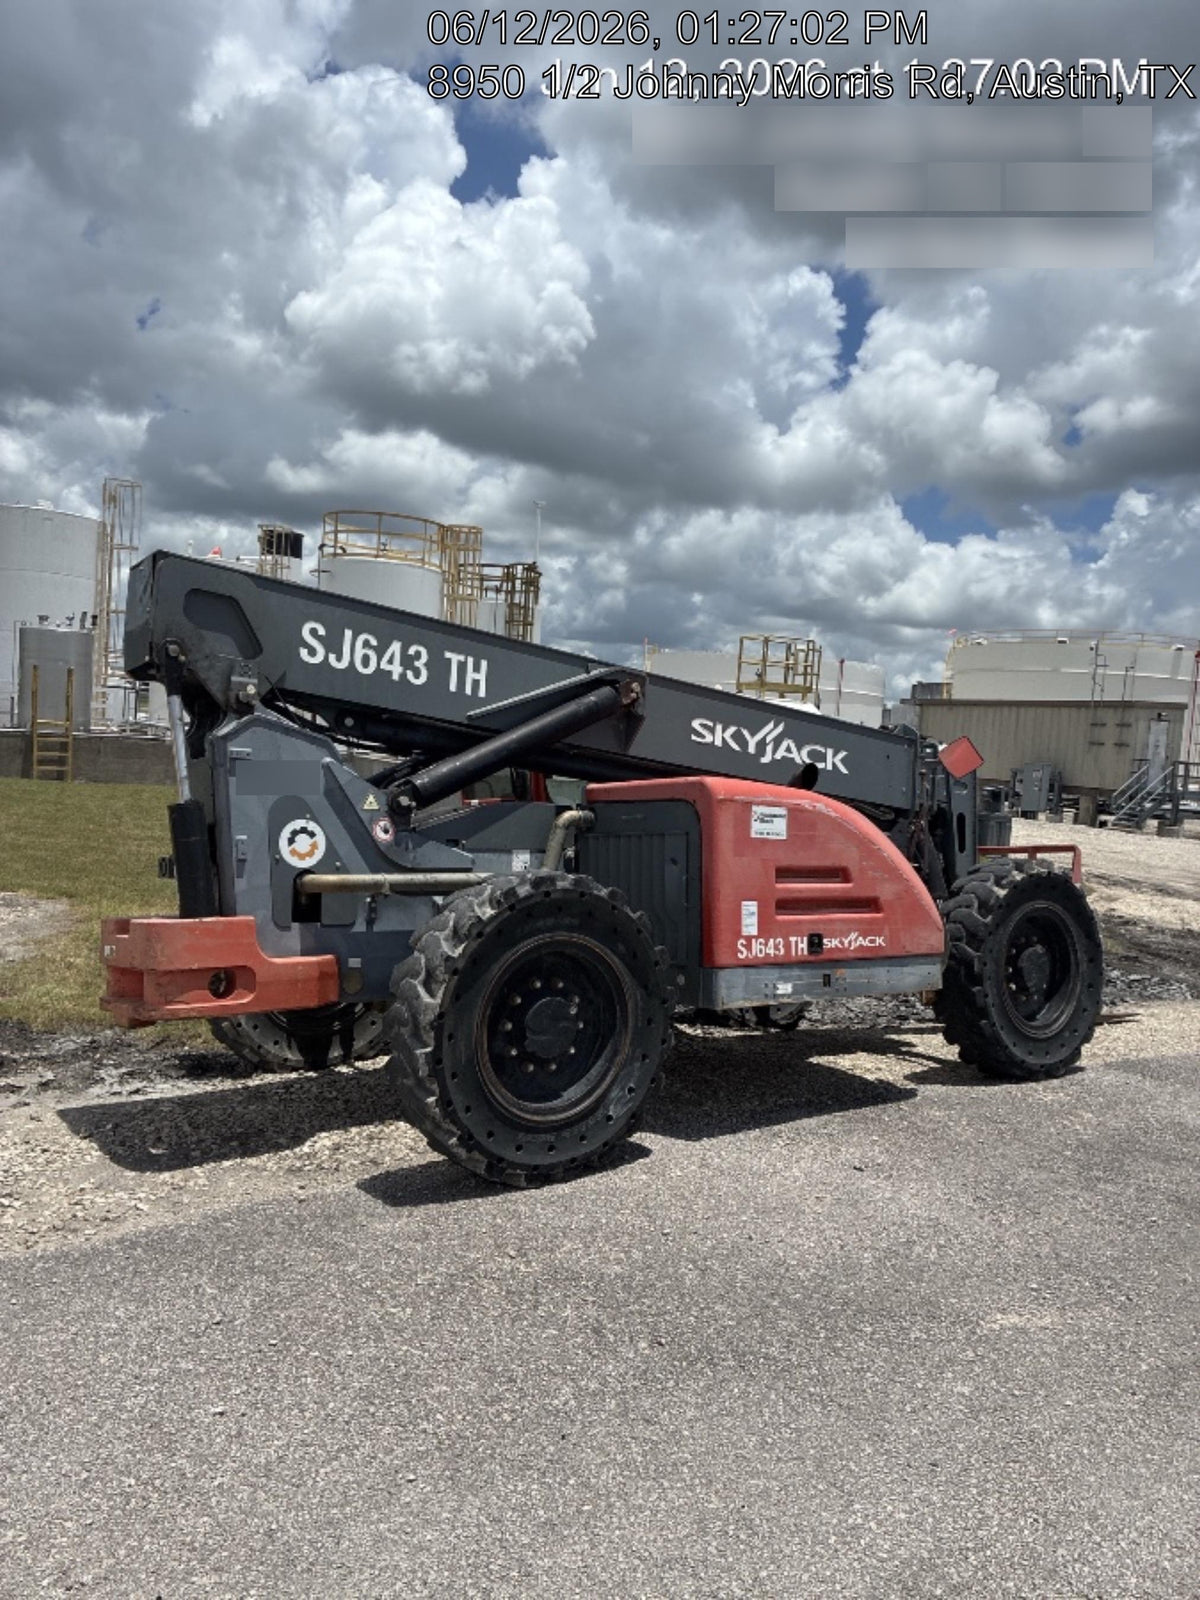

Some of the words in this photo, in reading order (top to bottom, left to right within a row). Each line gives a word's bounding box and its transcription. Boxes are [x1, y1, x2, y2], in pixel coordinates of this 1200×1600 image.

[299, 620, 429, 686] SJ643
[443, 650, 488, 698] TH
[690, 717, 849, 774] SKYJACK
[736, 937, 785, 960] SJ643
[788, 936, 808, 957] TH
[822, 931, 887, 951] SKYJACK
